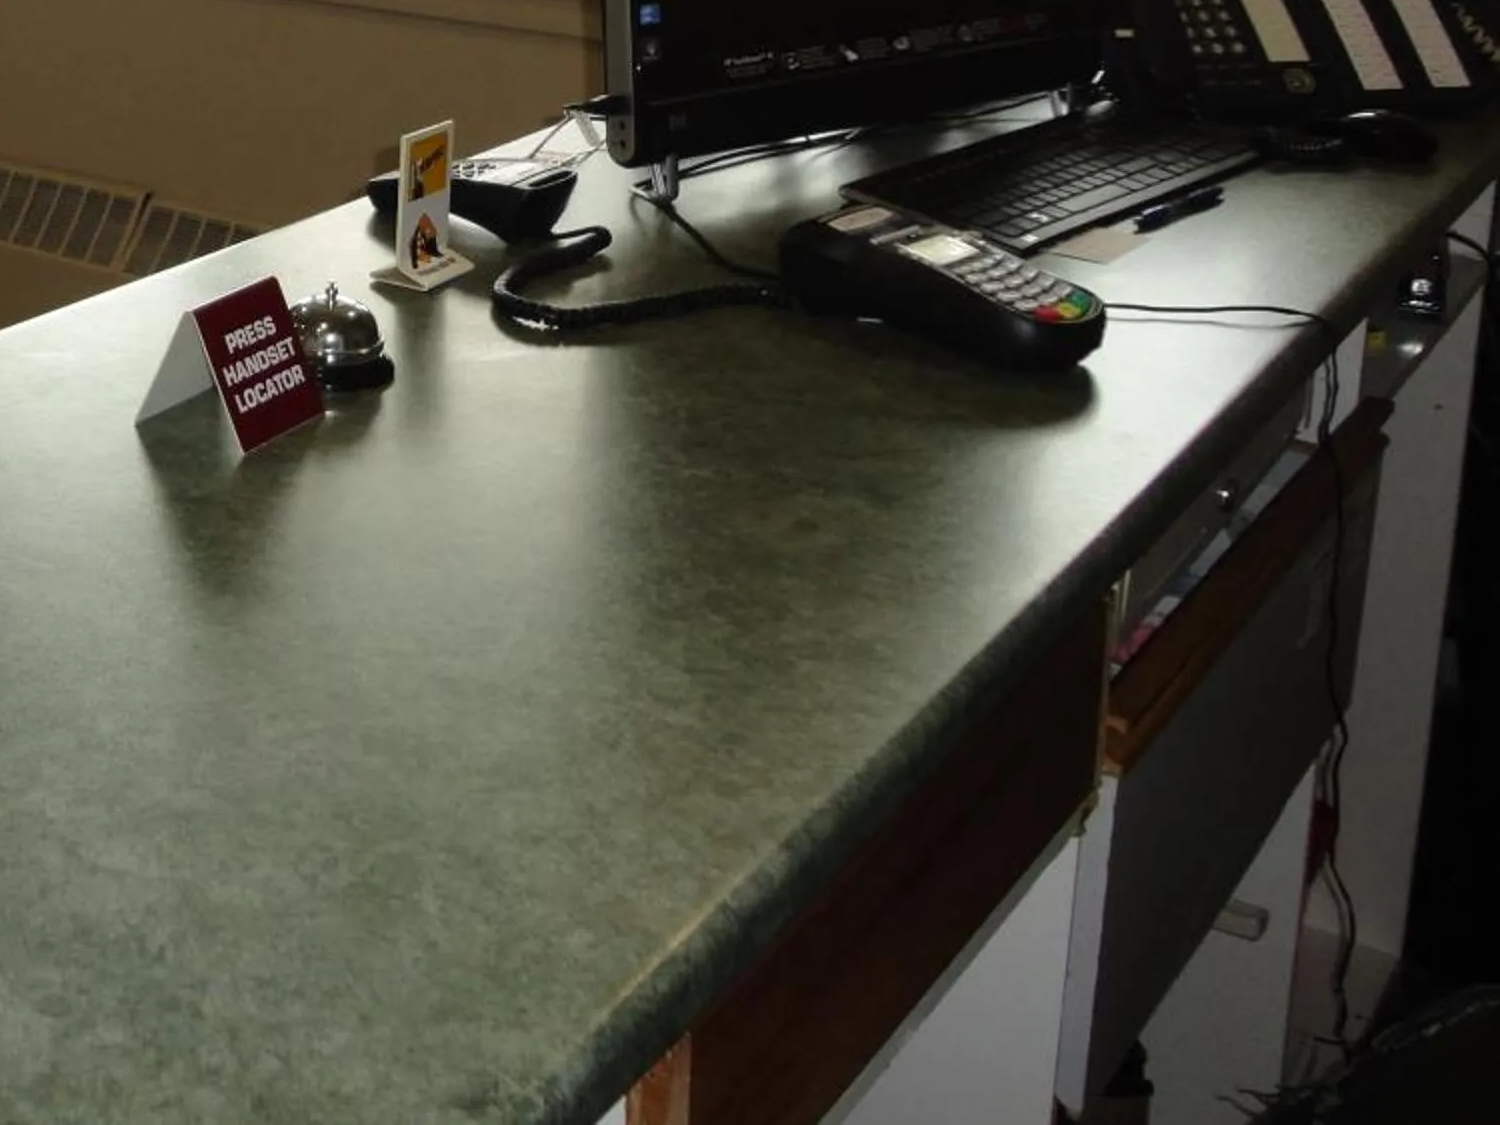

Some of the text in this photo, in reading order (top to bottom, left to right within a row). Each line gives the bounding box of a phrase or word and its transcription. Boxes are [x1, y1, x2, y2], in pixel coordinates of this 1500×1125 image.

[224, 315, 277, 355] PRESS
[222, 337, 296, 387] HANDSET
[234, 364, 305, 414] LOCATOR
